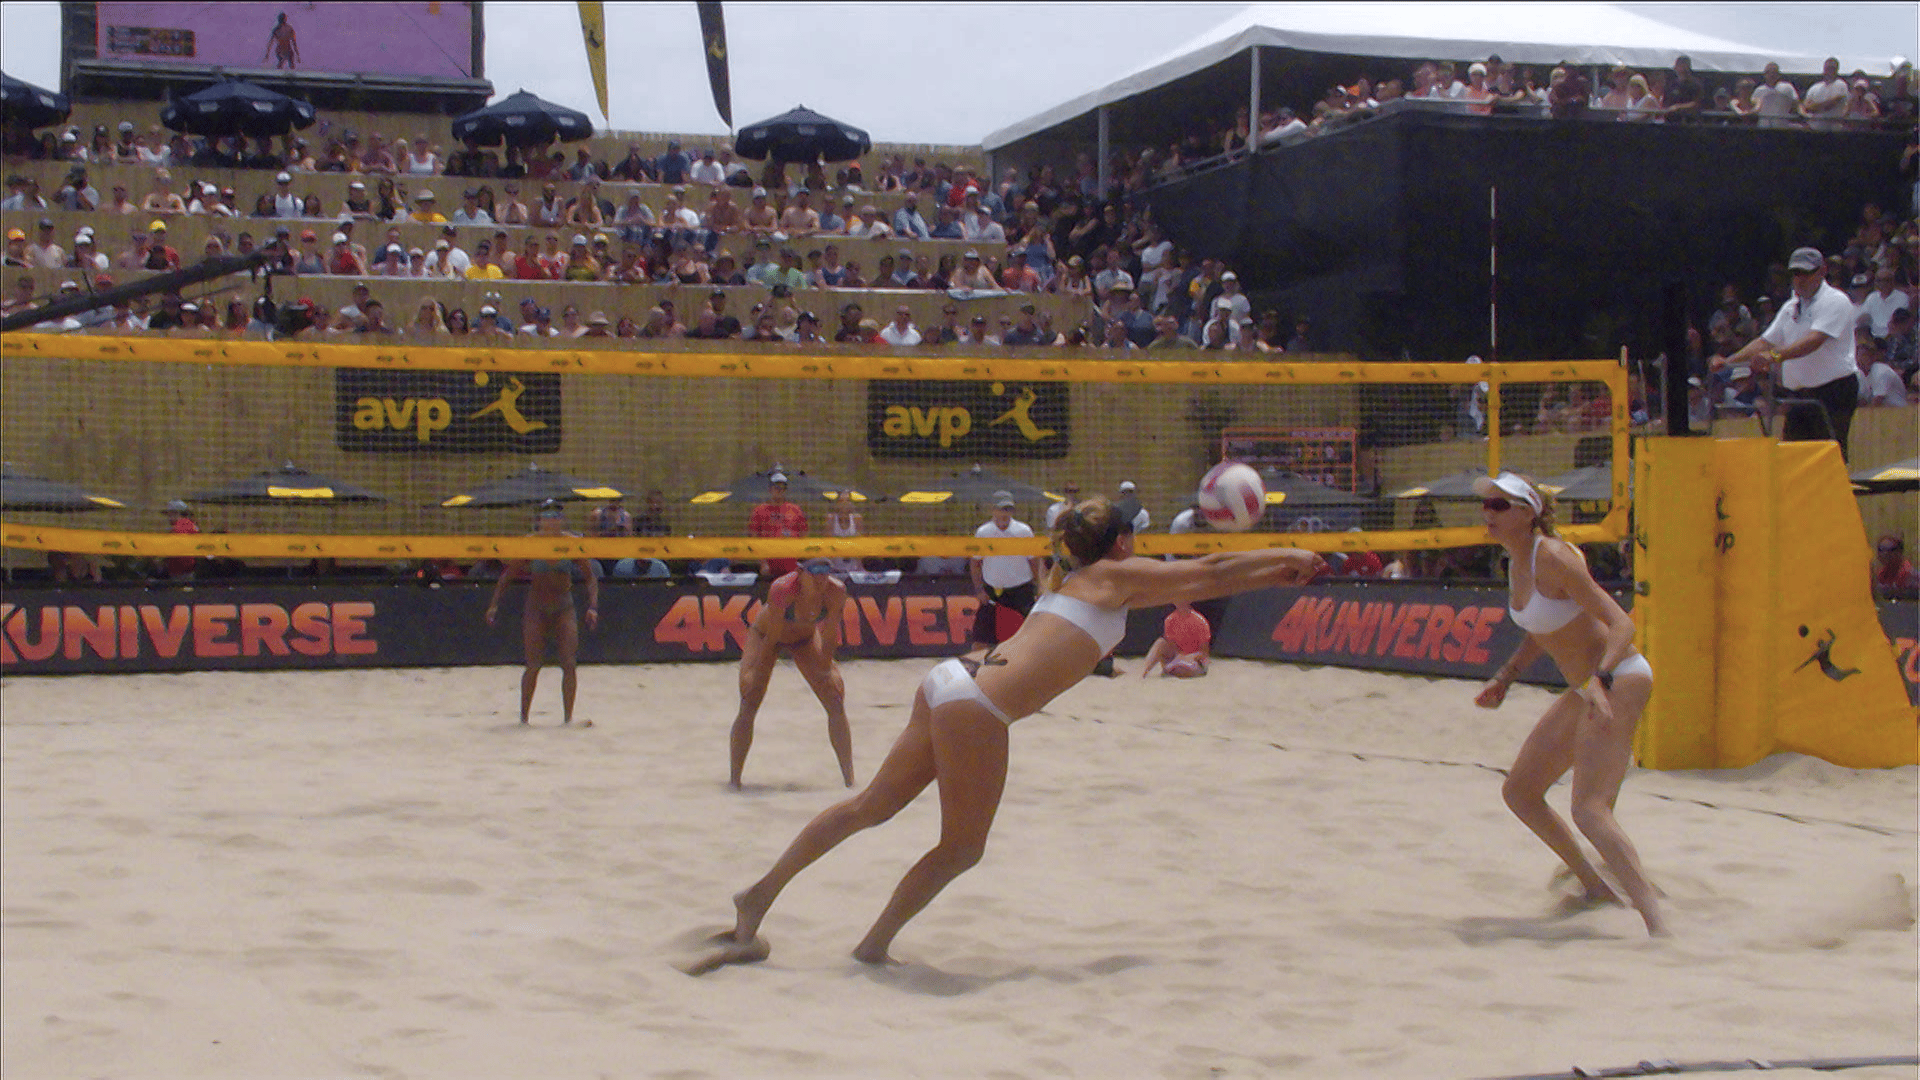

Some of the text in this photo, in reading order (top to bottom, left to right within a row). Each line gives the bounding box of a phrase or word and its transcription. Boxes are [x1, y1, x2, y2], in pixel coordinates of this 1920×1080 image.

[353, 397, 453, 443] avp
[883, 405, 972, 447] avp
[1272, 596, 1505, 663] 4KUNIVERSE
